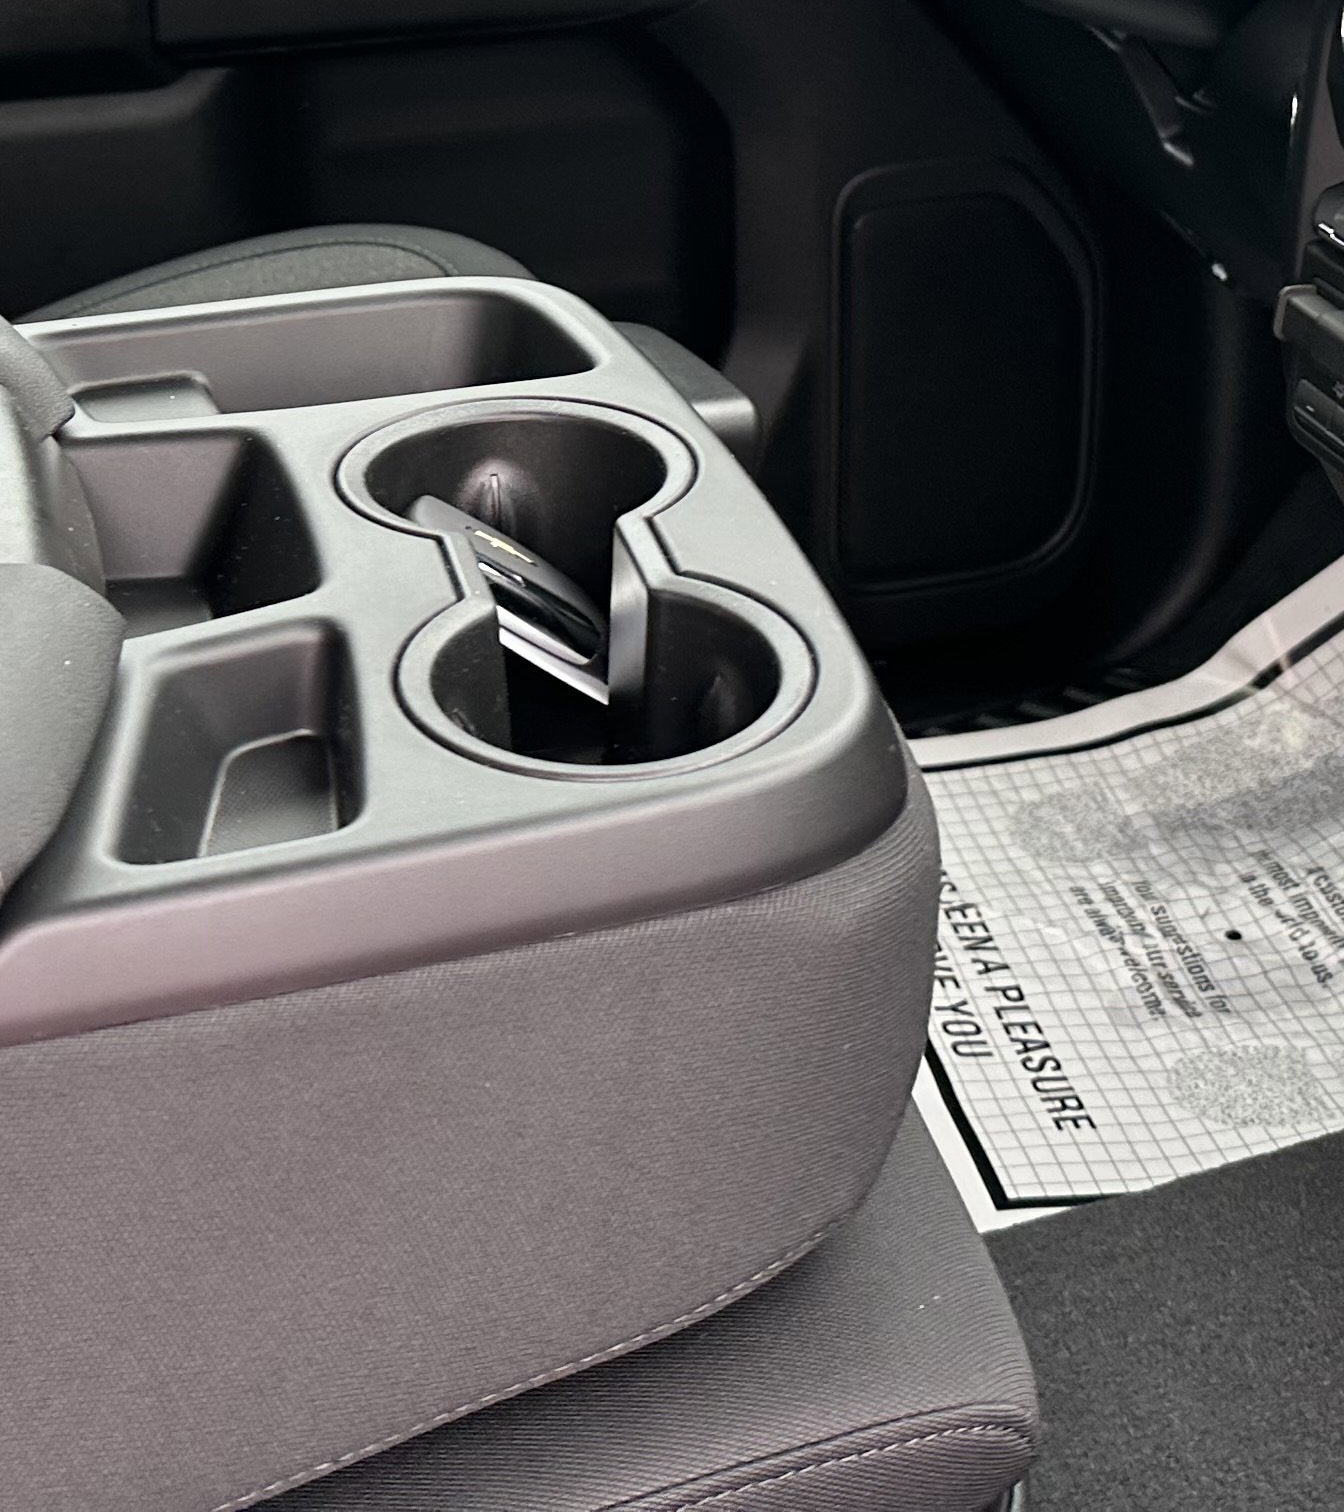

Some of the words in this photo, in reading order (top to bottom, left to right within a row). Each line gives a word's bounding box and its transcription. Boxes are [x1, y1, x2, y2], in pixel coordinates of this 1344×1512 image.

[1261, 859, 1301, 892] most
[1069, 886, 1094, 906] are
[1247, 882, 1274, 907] the
[1298, 940, 1320, 961] to
[1310, 963, 1334, 989] us.
[971, 957, 1011, 976] A
[1206, 993, 1232, 1014] for
[934, 999, 994, 1058] YOU
[984, 983, 1097, 1132] PLEASURE
